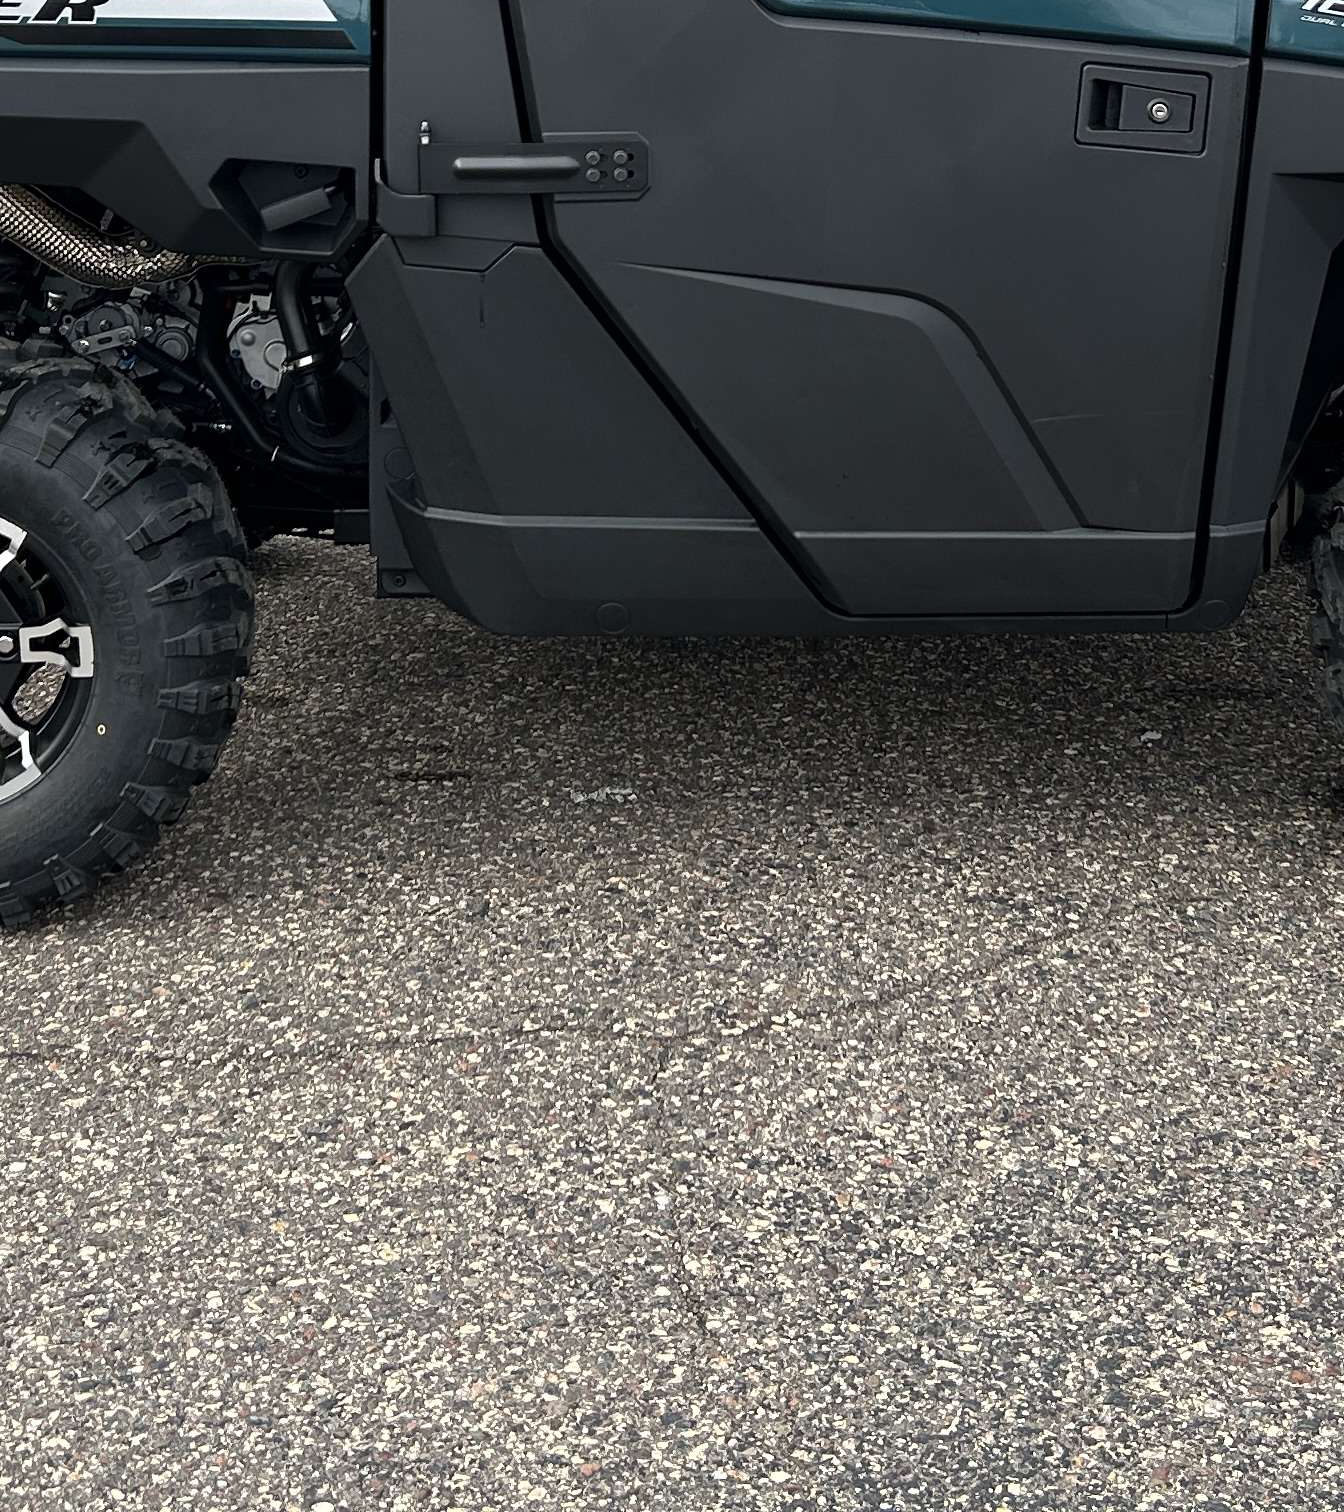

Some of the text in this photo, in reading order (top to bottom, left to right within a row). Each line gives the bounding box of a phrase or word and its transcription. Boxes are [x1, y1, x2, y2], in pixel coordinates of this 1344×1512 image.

[1299, 14, 1339, 27] DUAL
[49, 508, 141, 666] PRO ARMOR
